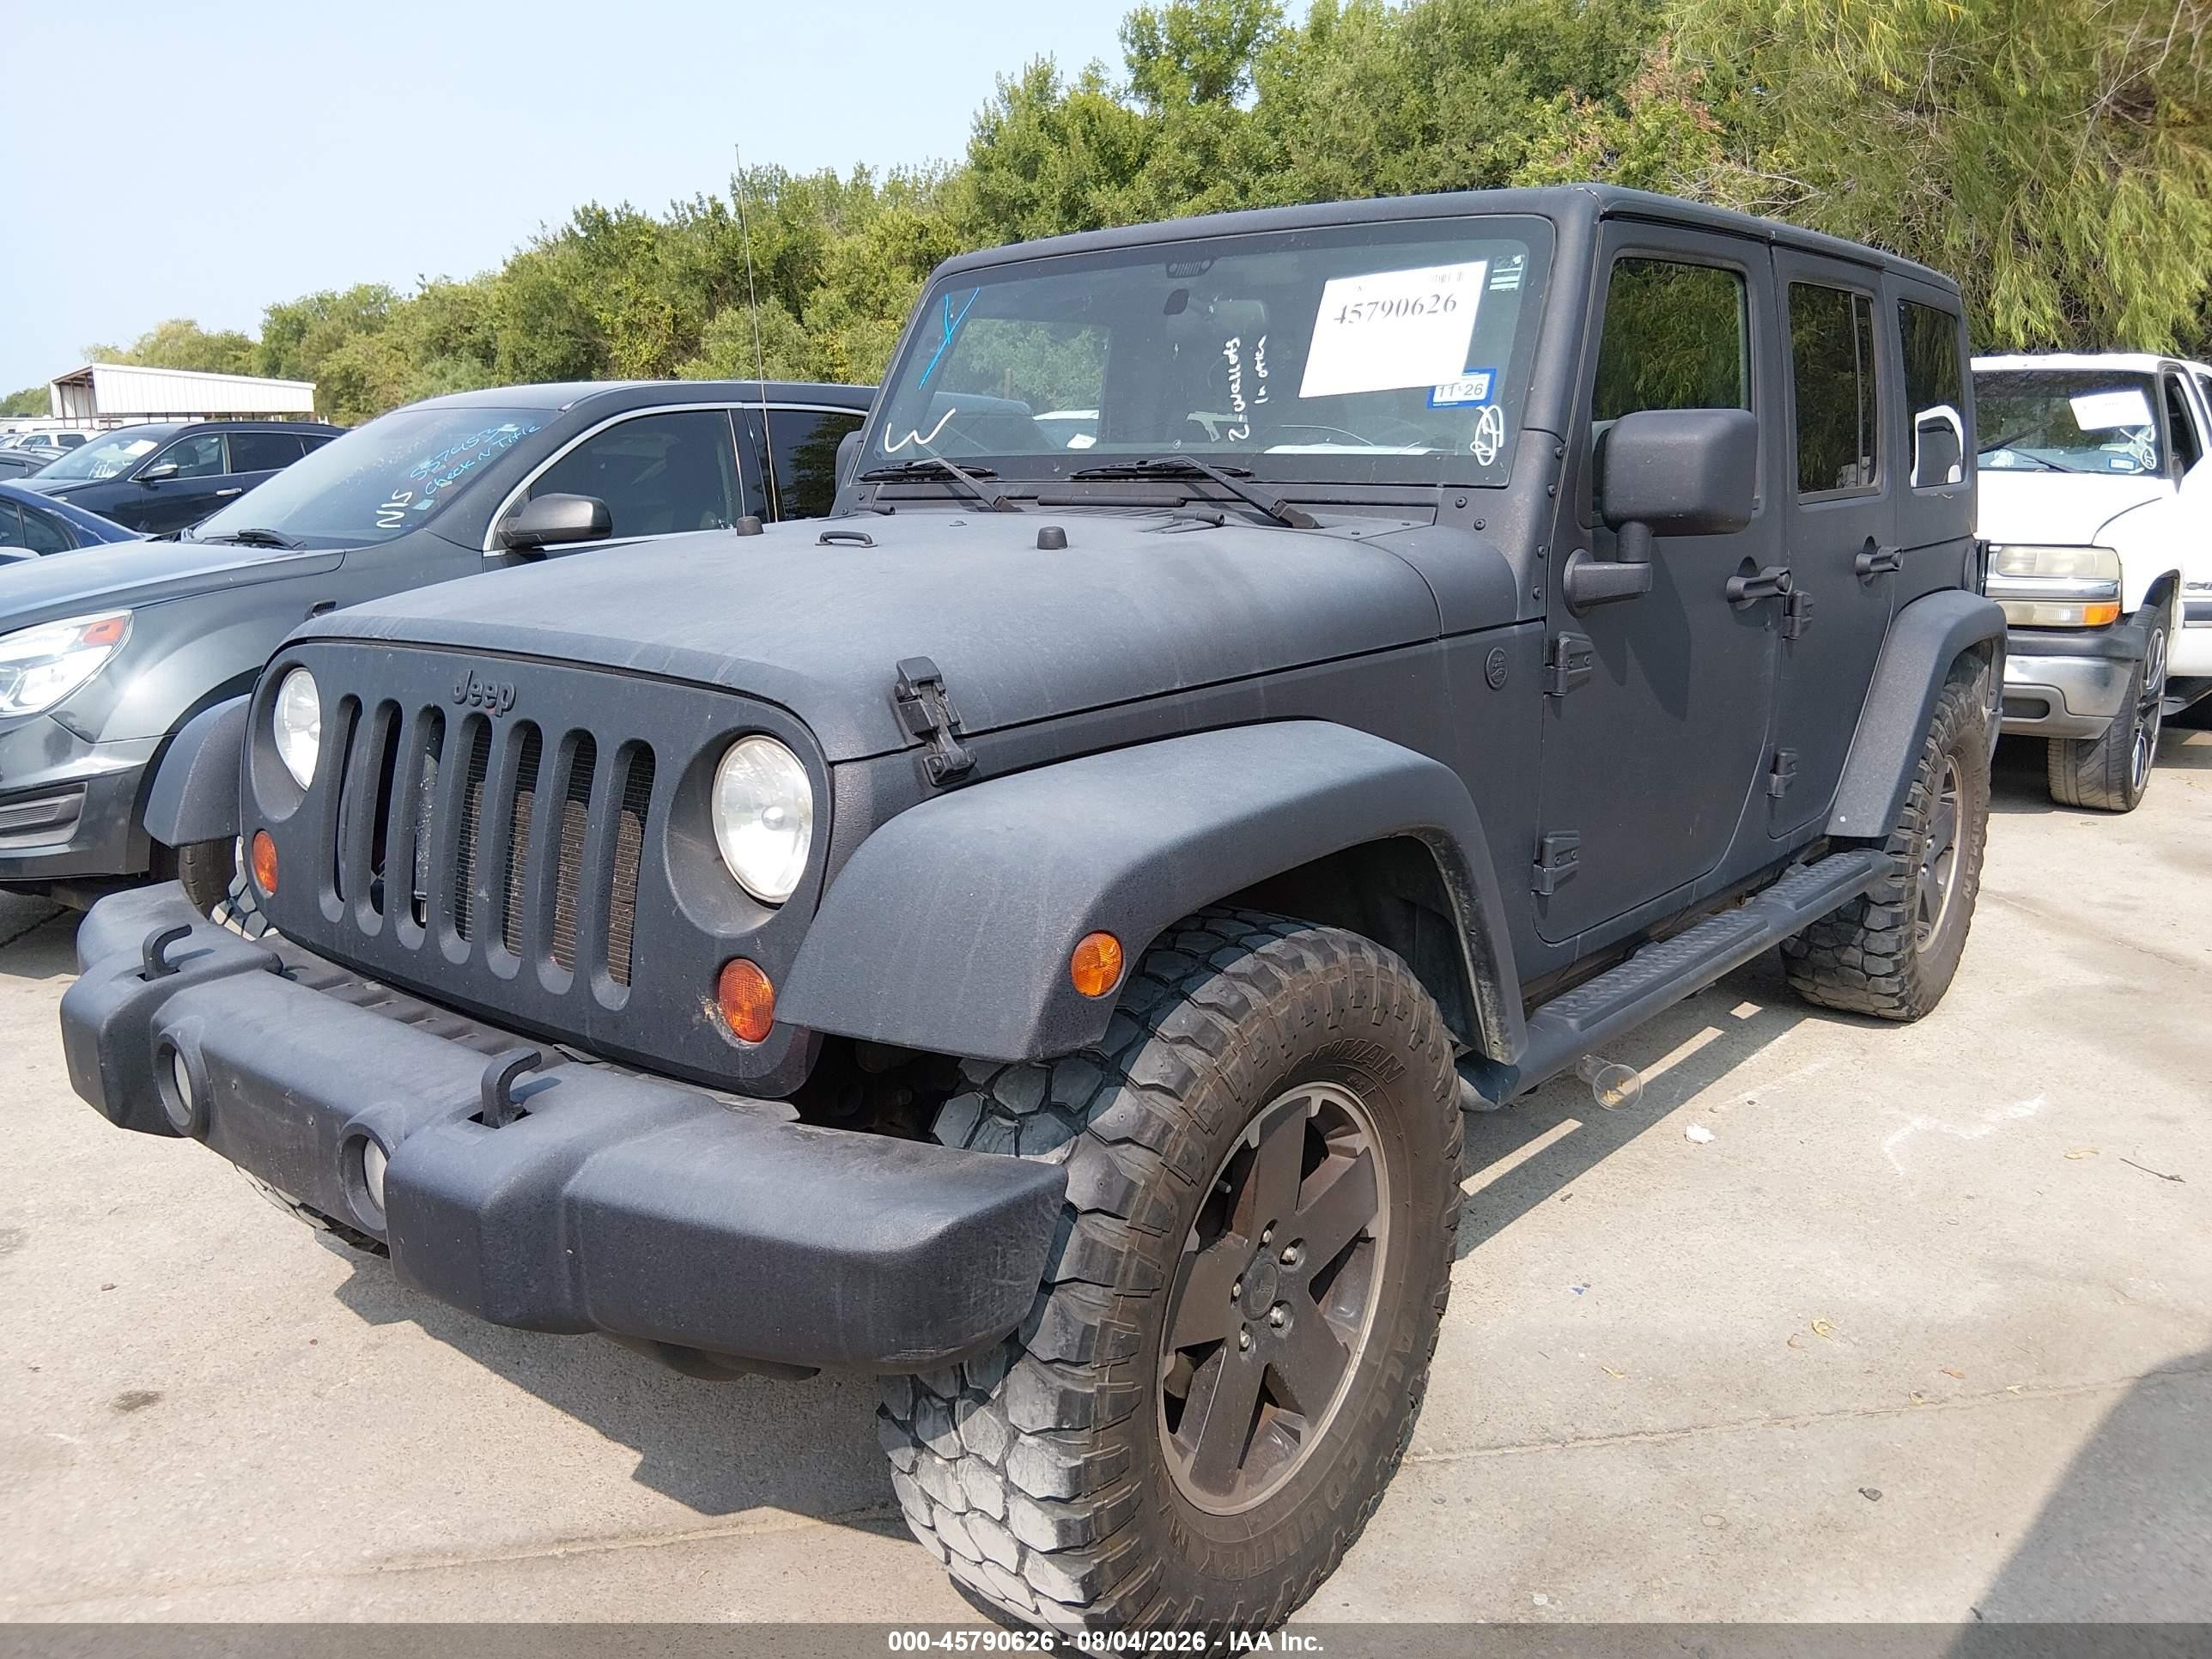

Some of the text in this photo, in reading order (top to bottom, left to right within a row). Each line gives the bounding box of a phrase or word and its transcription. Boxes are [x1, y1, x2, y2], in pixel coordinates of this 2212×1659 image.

[1333, 293, 1458, 325] 45790626
[425, 459, 475, 495] Check
[492, 425, 543, 447] Title
[453, 669, 517, 718] Jeep
